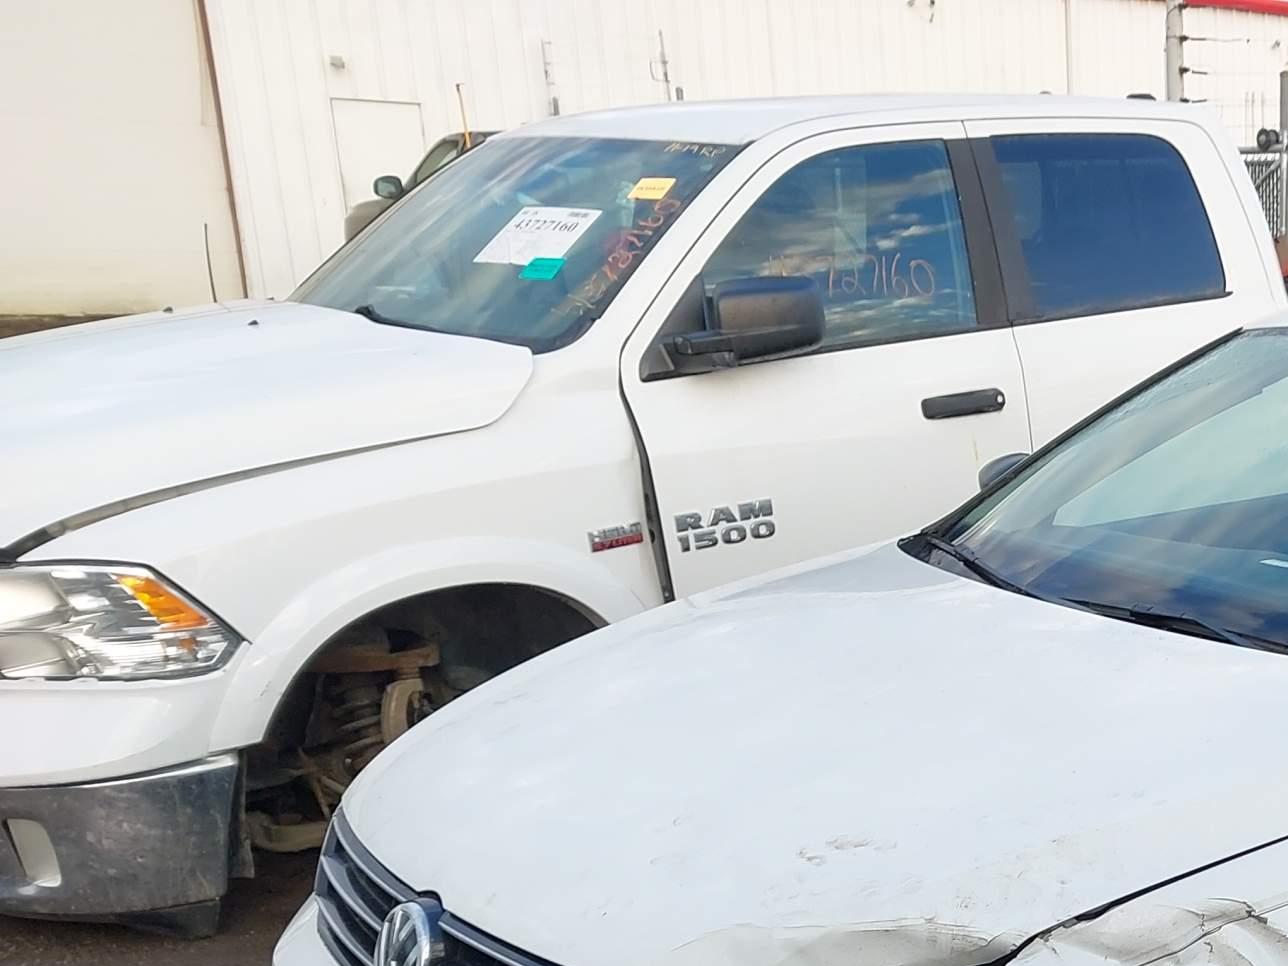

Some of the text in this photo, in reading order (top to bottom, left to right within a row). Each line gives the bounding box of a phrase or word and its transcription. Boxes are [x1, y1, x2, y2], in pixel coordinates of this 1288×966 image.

[514, 219, 580, 233] 43727160
[674, 499, 774, 532] RAM
[676, 519, 776, 553] 1500
